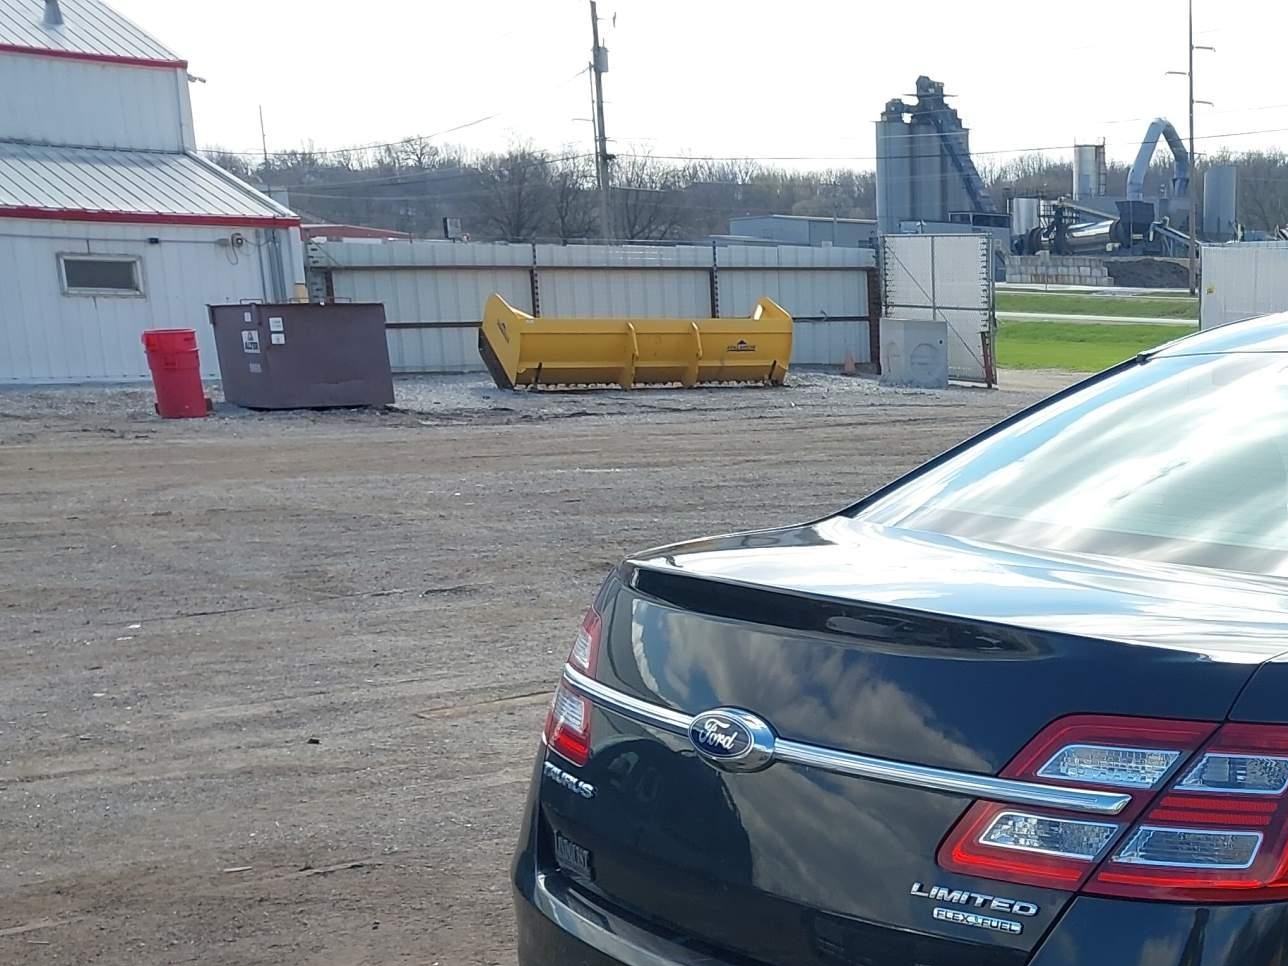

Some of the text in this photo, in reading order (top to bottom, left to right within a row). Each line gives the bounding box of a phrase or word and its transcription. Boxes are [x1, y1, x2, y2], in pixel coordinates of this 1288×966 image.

[699, 718, 738, 750] Ford
[544, 760, 594, 799] TAURUS
[910, 882, 1039, 917] LIMITED
[936, 908, 1018, 933] FLEX FUEL
